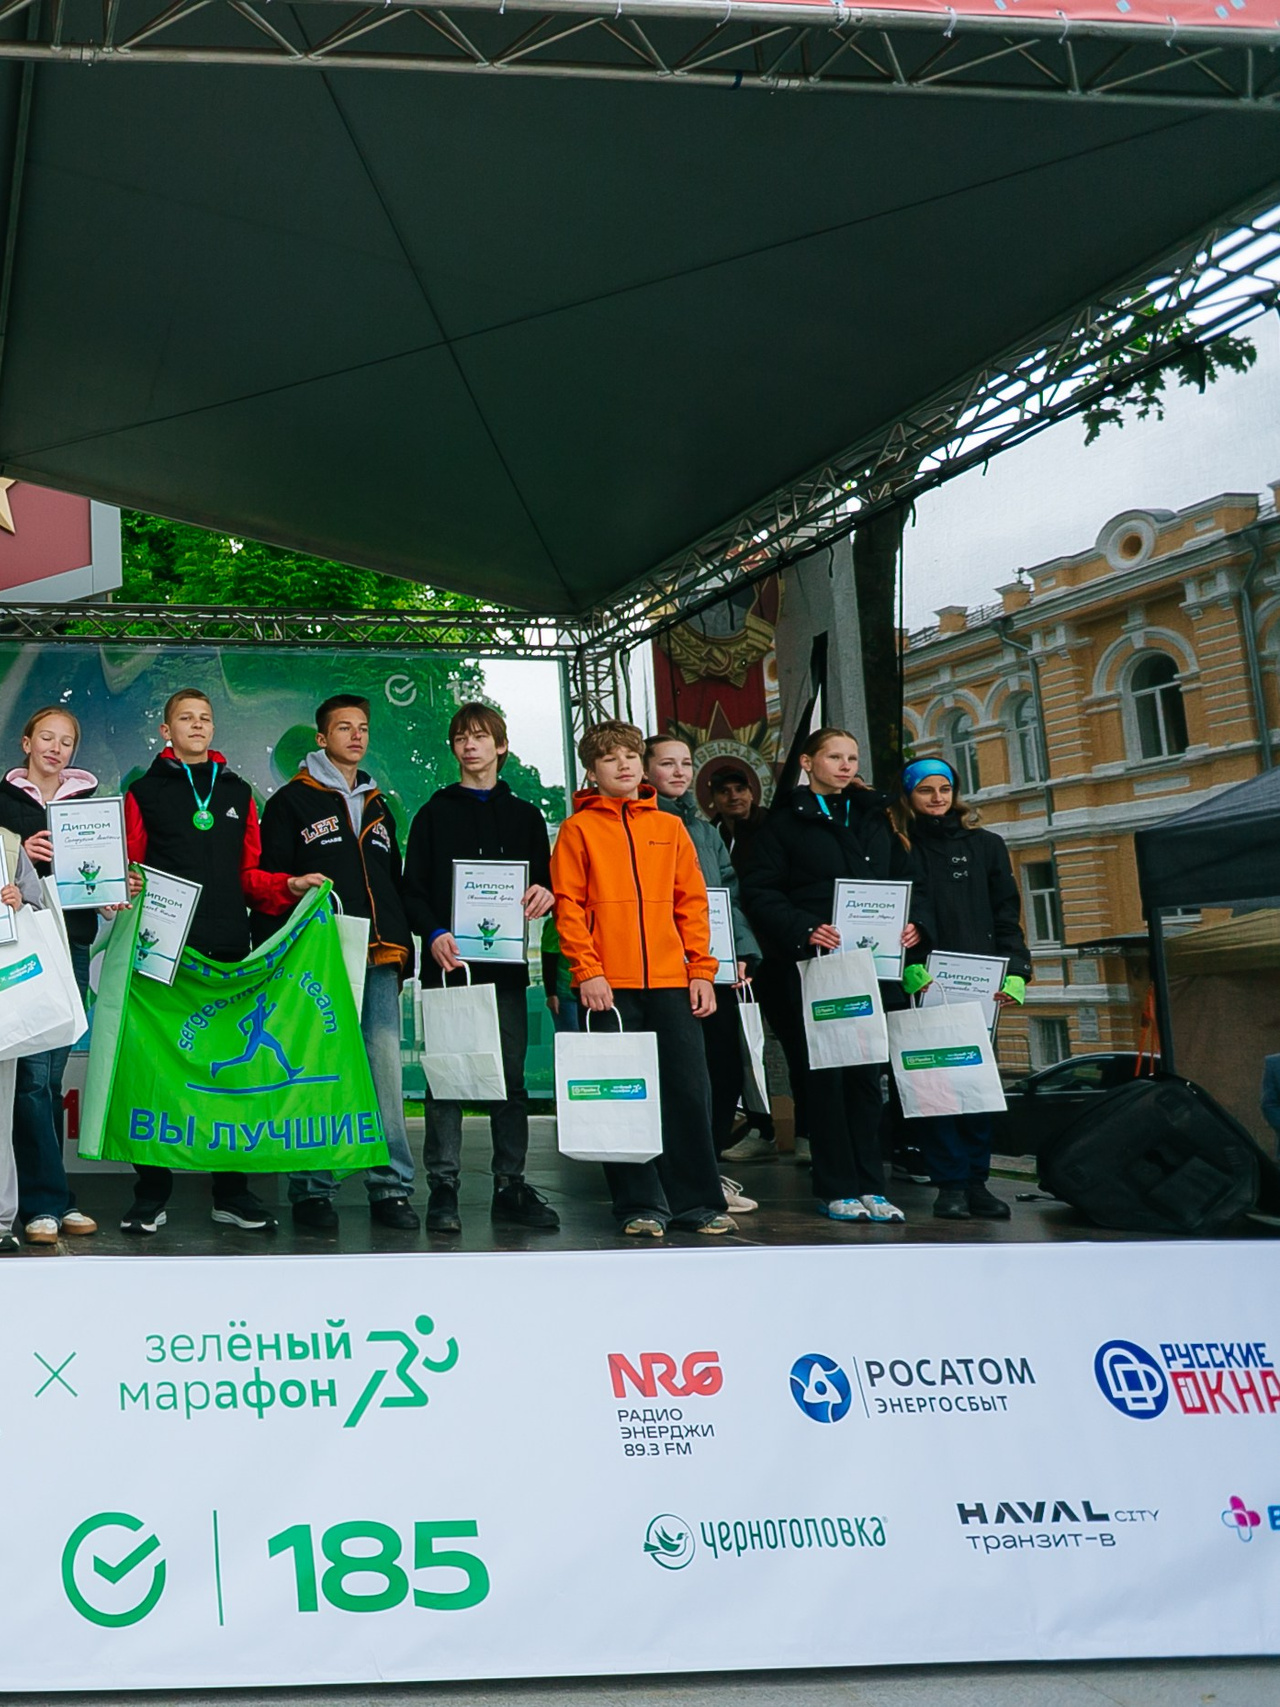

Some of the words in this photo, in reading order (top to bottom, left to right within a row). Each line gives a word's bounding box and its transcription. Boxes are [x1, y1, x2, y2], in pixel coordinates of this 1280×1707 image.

[60, 822, 111, 832] Диплом
[301, 816, 339, 844] LET
[464, 881, 514, 890] Диплом
[845, 900, 895, 909] Диплом
[936, 971, 990, 983] Диплом
[299, 970, 339, 1033] team
[129, 1107, 196, 1147] ВЫ
[206, 1111, 385, 1152] ЛУЧШИЕ!
[146, 1319, 352, 1362] зелёный
[1160, 1343, 1274, 1369] РУССКИЕ
[607, 1351, 724, 1399] NRG
[868, 1357, 1036, 1388] РОСАТОМ
[119, 1366, 338, 1420] марафон
[875, 1395, 1008, 1414] ЭНЕРГОСБЫТ
[617, 1408, 683, 1424] РАДИО
[620, 1424, 715, 1441] ЭНЕРДЖИ
[623, 1442, 660, 1457] 89.3
[664, 1441, 692, 1456] FM
[956, 1500, 1111, 1525] HAVAL
[1114, 1509, 1160, 1522] CITY
[267, 1519, 491, 1613] 185
